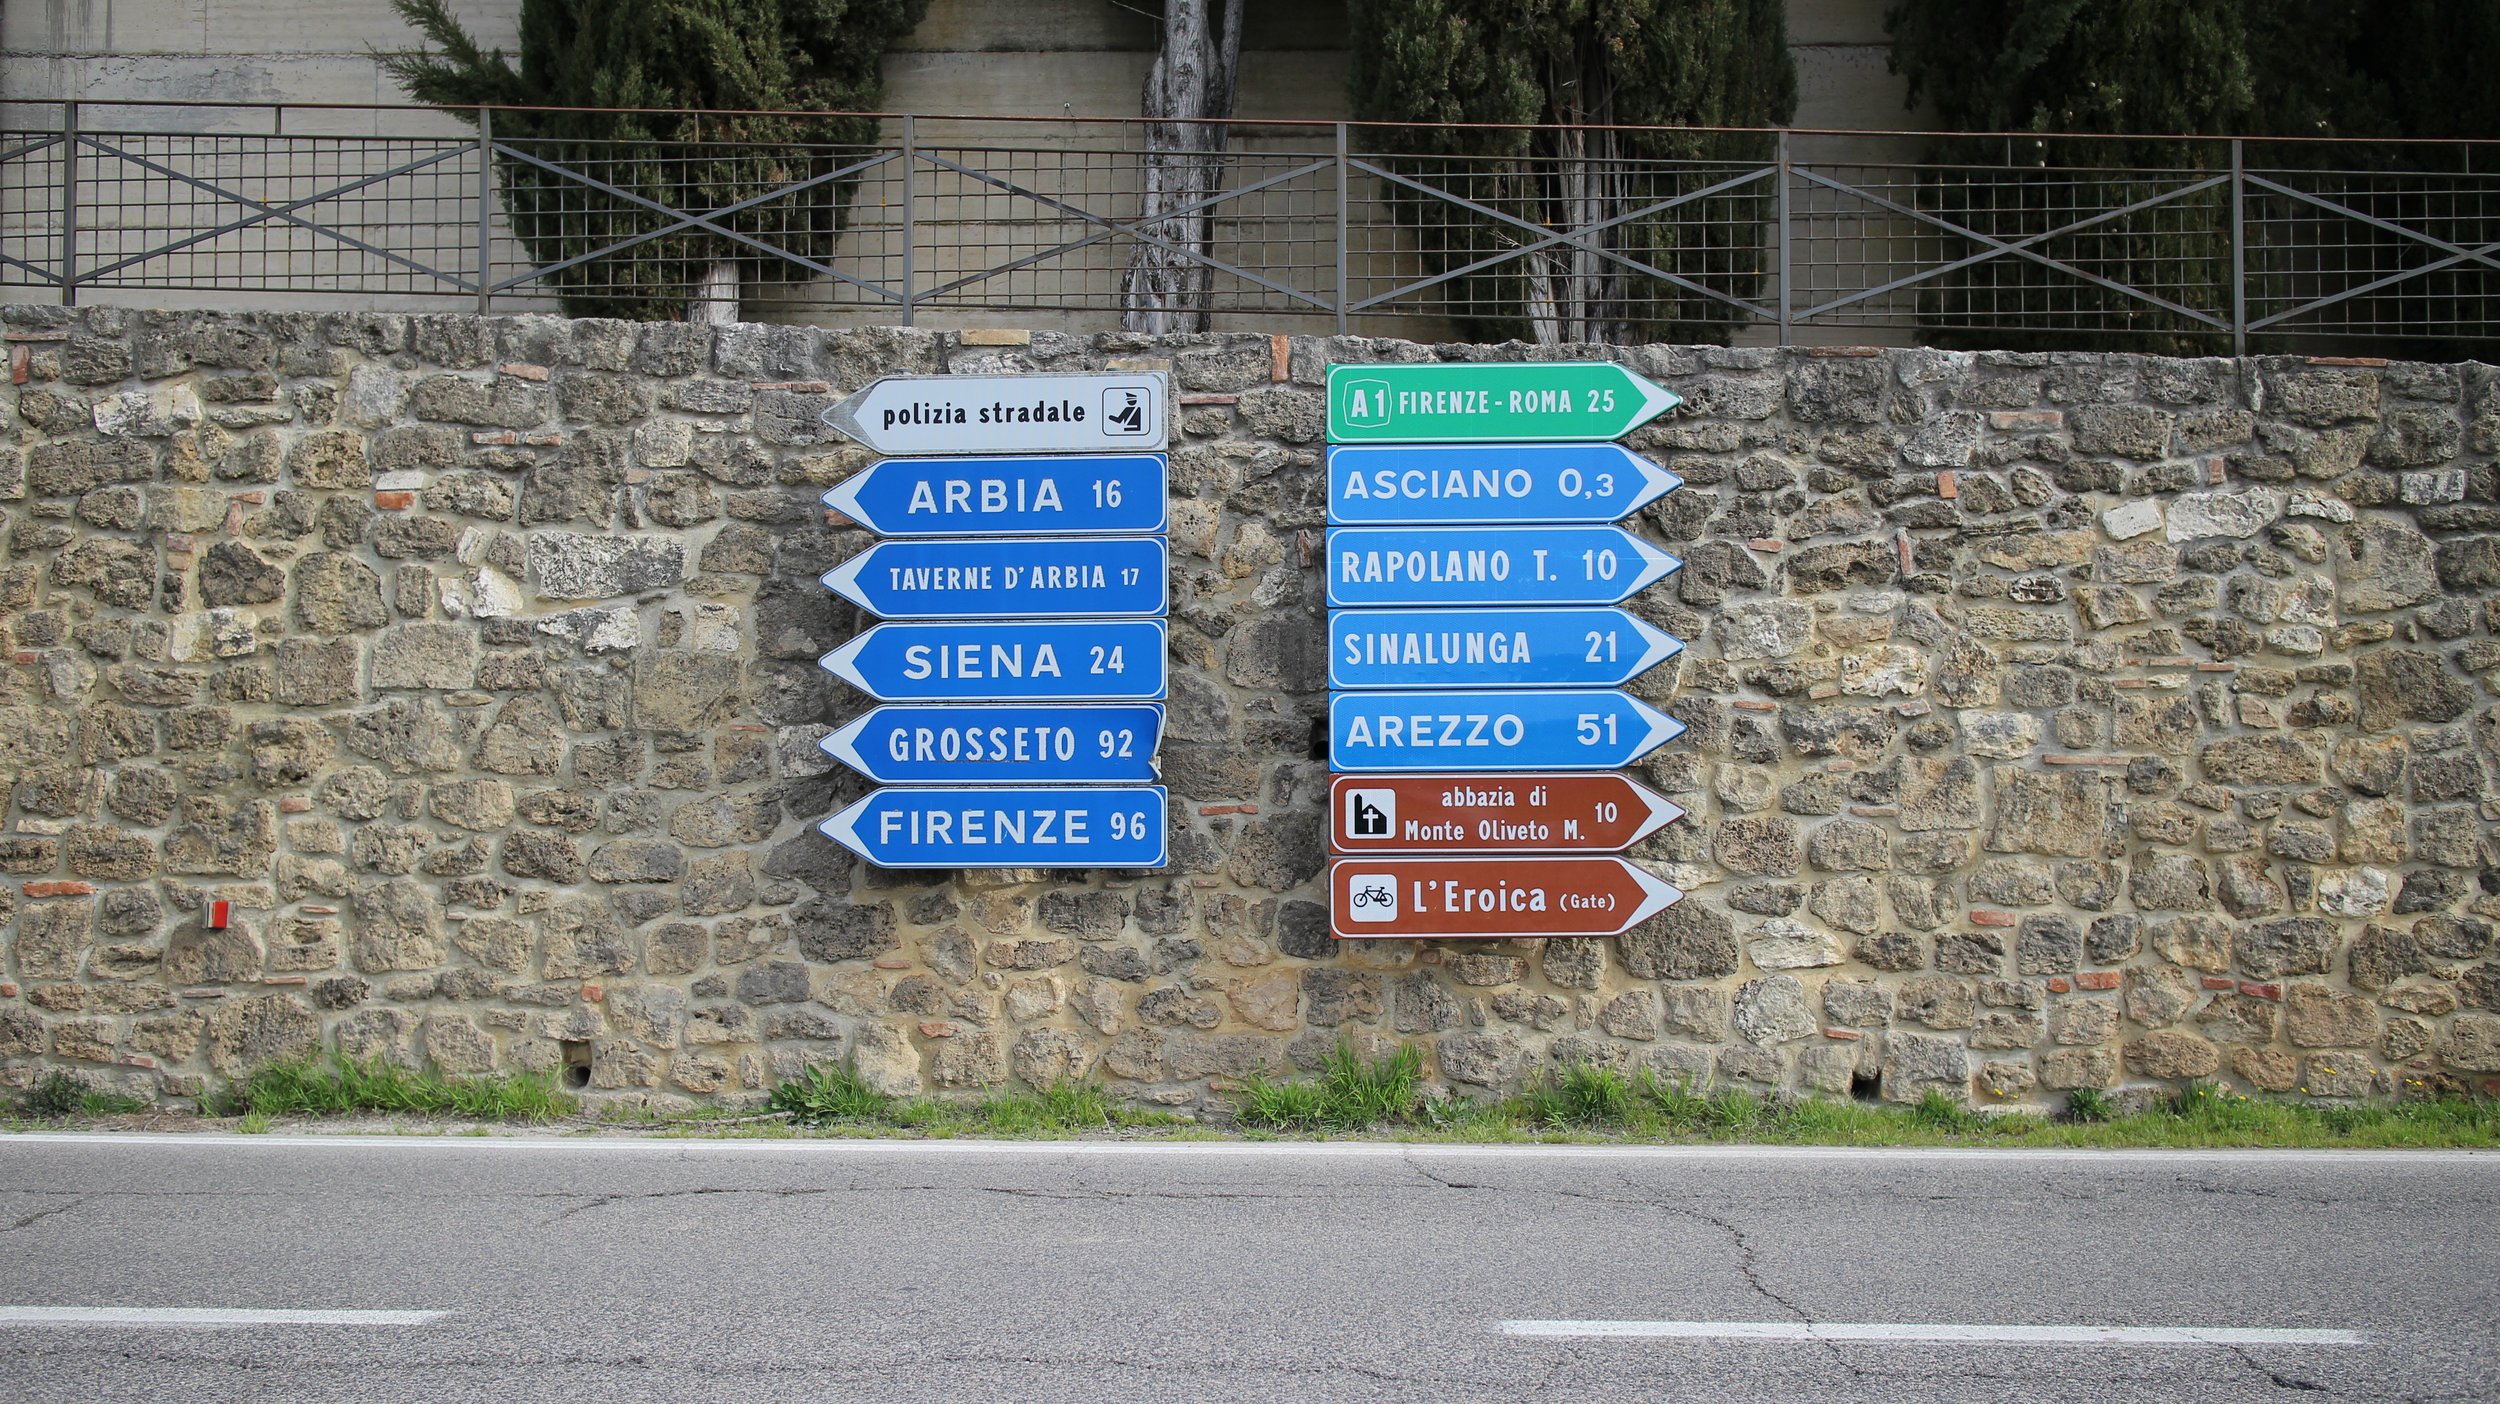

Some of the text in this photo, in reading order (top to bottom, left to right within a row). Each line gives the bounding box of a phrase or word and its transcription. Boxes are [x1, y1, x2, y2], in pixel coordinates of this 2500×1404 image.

[883, 400, 1086, 430] polizia stradale
[1351, 389, 1385, 418] A1
[1588, 389, 1615, 412] 25
[908, 479, 1122, 514] ARBIA 16
[1344, 469, 1532, 499] ASCIANO
[890, 566, 992, 590] TAVERNE
[1121, 568, 1139, 585] 17
[1342, 549, 1617, 582] RAPOLANO T. 10
[903, 644, 1124, 680] SIENA 24
[1345, 631, 1616, 665] SINALUNGA 21
[890, 727, 1133, 761] GROSSETO 92
[1346, 713, 1616, 747] AREZZO 51
[1442, 786, 1547, 807] abbazia di
[881, 809, 1146, 844] FIRENZE 96
[1595, 802, 1617, 823] 10
[1405, 819, 1585, 841] Monte Oliveto M.
[1560, 894, 1616, 912] (Gate)
